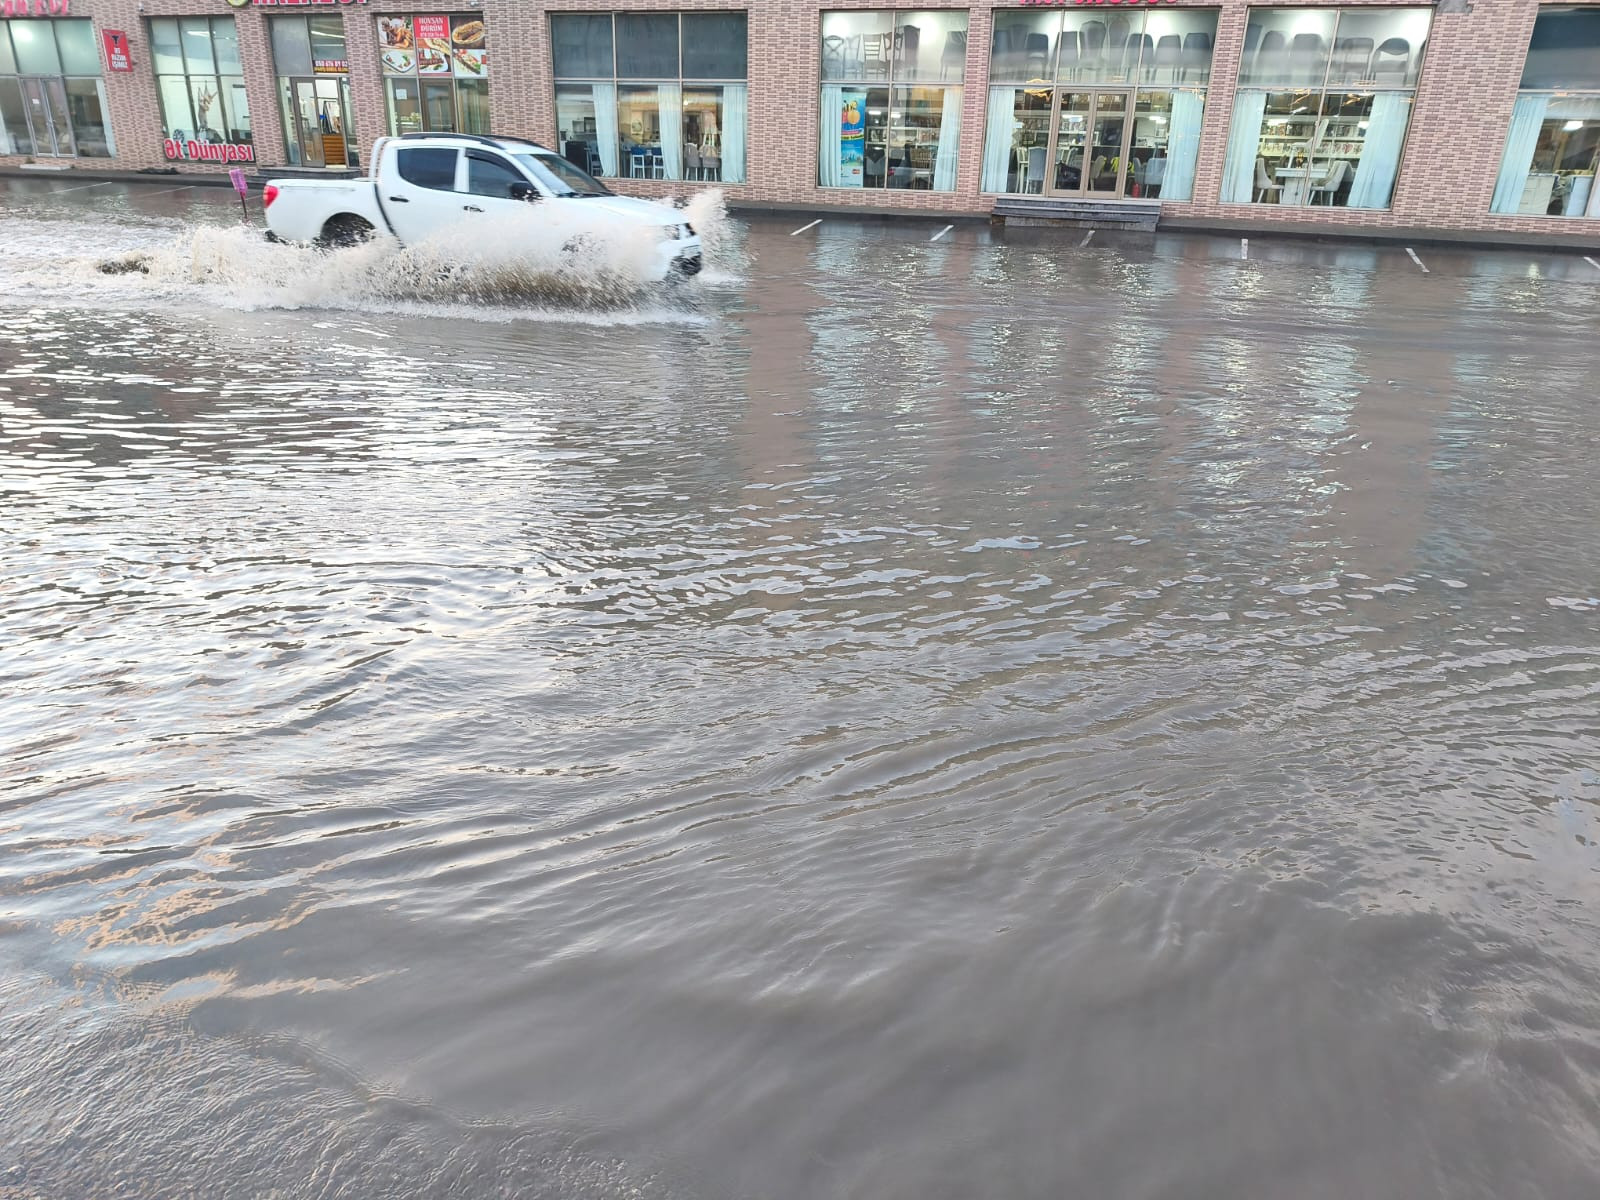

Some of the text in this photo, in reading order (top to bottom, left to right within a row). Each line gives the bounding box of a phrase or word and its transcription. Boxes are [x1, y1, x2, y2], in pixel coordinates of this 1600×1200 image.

[420, 24, 443, 32] DÜRÜM
[164, 138, 254, 164] Ət Dünyası
